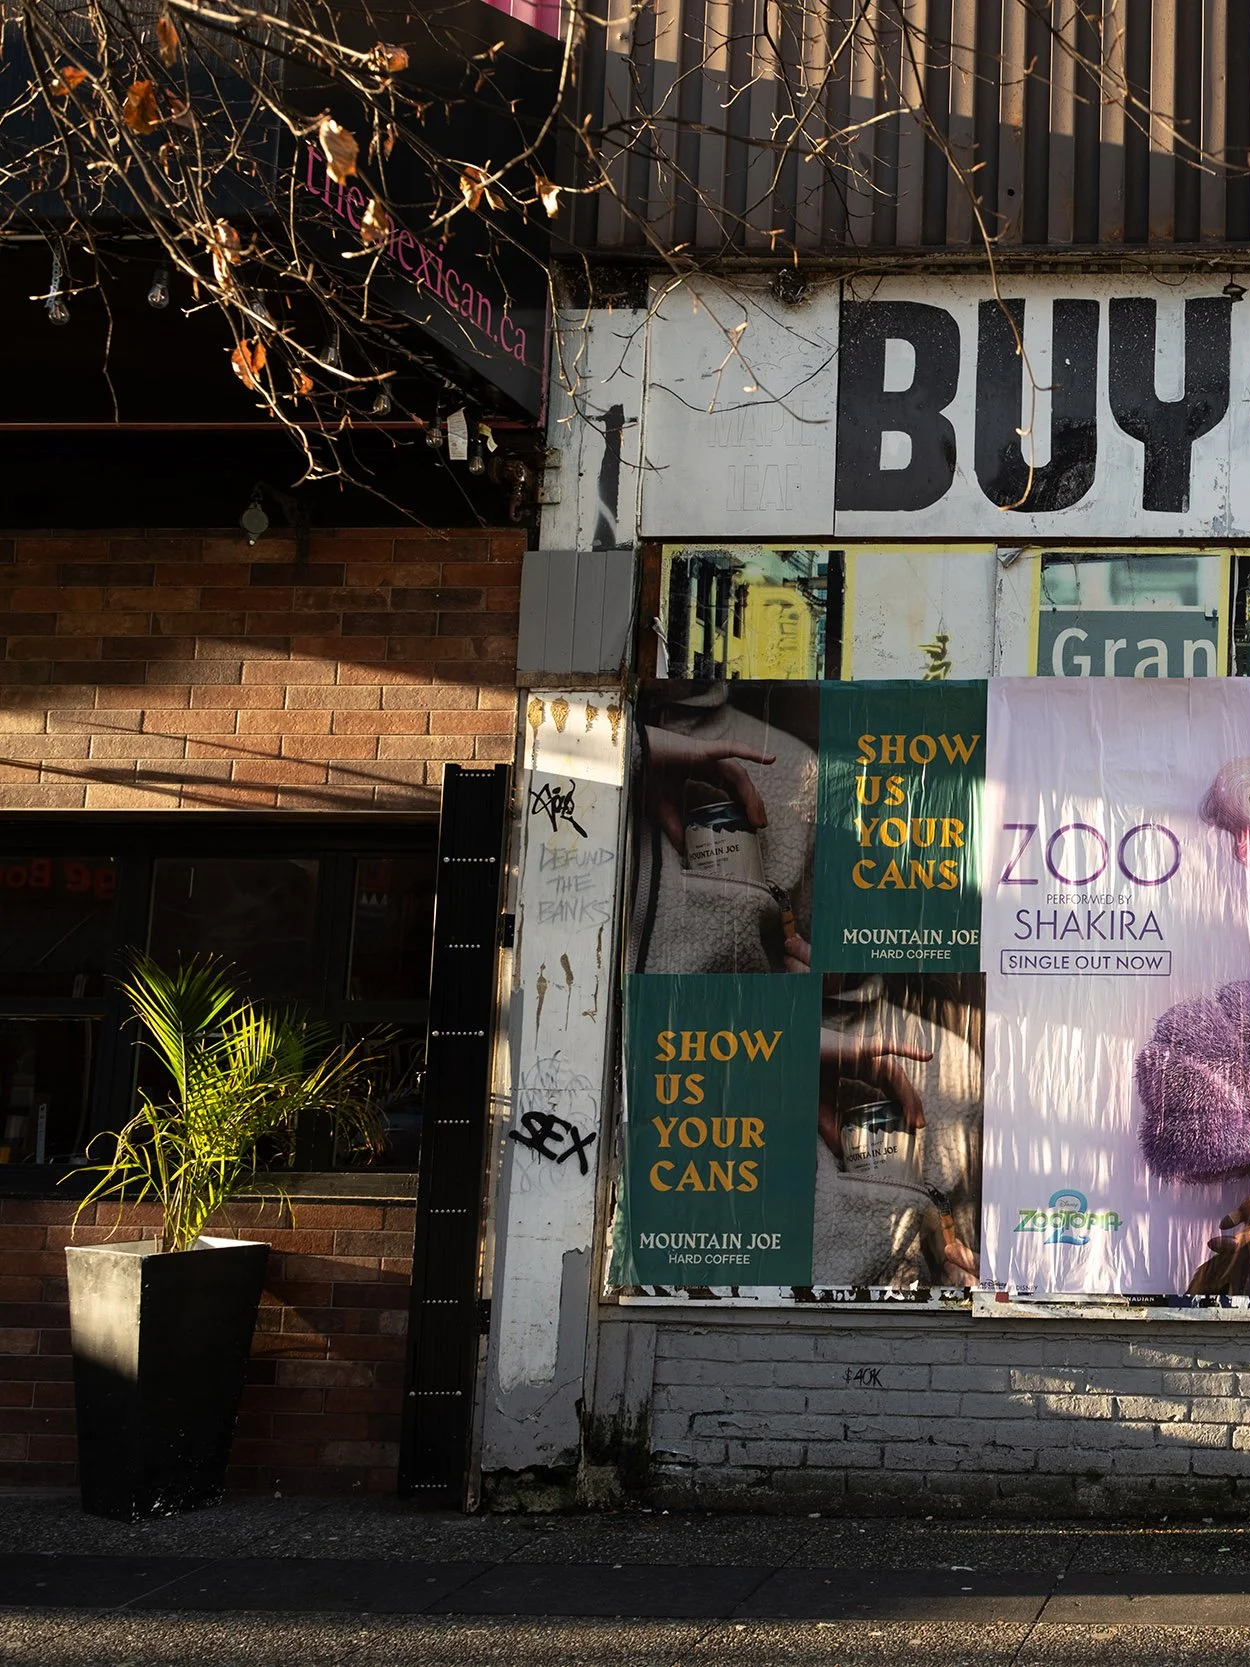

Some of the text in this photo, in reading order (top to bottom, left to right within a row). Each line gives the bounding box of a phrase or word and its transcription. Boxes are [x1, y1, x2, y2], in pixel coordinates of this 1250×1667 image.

[836, 297, 1234, 514] BUY
[1052, 627, 1218, 678] Gran
[855, 733, 982, 765] SHOW
[855, 775, 905, 806] US
[853, 817, 965, 848] YOUR
[1000, 823, 1182, 886] ZOO
[546, 872, 597, 893] THE
[852, 858, 960, 890] CANS
[1046, 893, 1132, 905] PERFORMED BY
[537, 898, 612, 934] BANKS
[1014, 909, 1164, 941] SHAKIRA
[843, 928, 979, 945] MOUNTAIN JOE
[871, 949, 951, 960] HARD COFFEE
[1008, 955, 1163, 970] SINGLE OUT NOW
[655, 1029, 783, 1062] SHOW
[654, 1073, 705, 1105] US
[508, 1111, 597, 1176] SEX
[651, 1116, 766, 1148] YOUR
[650, 1160, 759, 1193] CANS
[640, 1232, 782, 1250] MOUNTAIN JOE
[668, 1253, 750, 1264] HARD COFFEE
